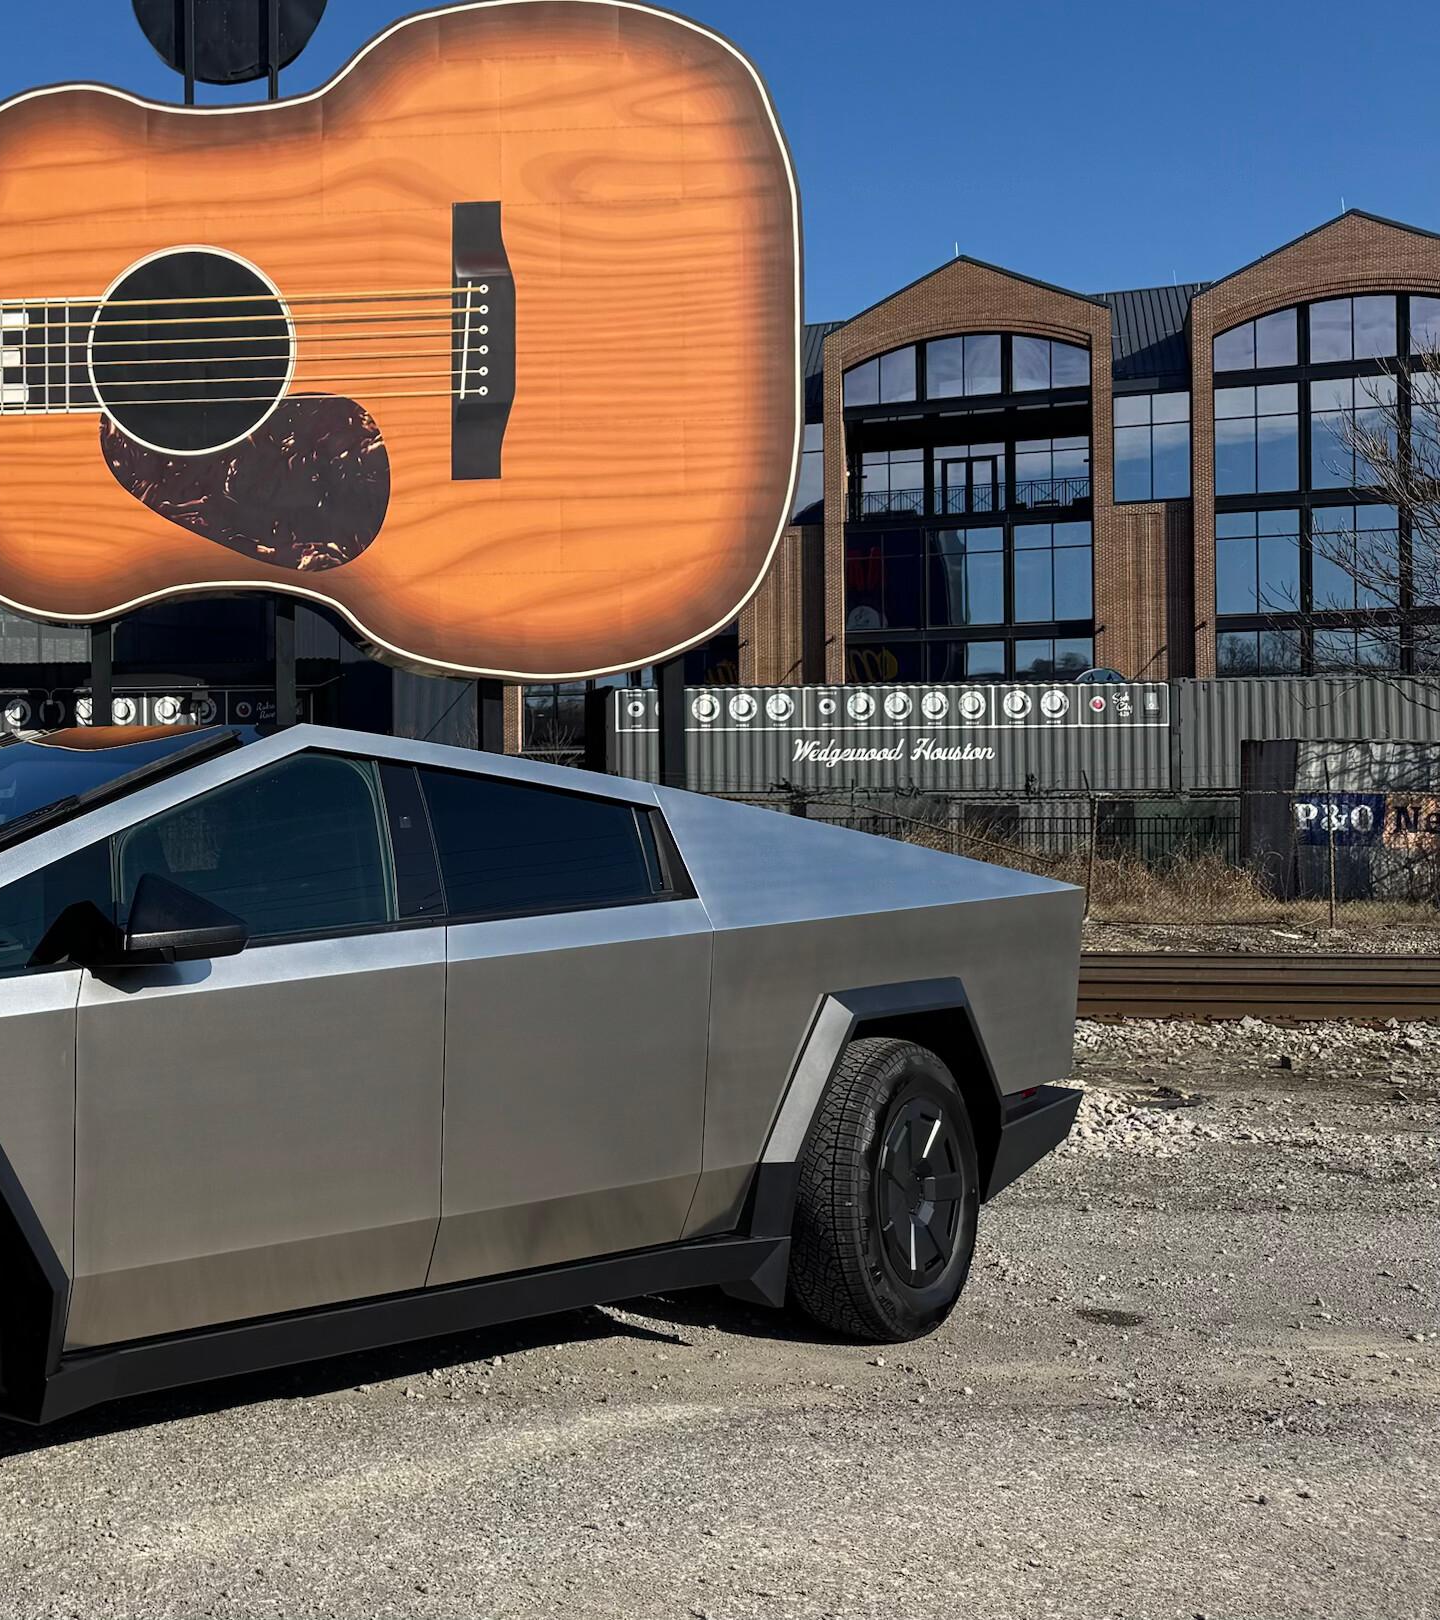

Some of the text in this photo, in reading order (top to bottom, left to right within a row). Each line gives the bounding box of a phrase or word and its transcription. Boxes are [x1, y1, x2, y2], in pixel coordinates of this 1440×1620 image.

[791, 738, 995, 767] Wedgewood Houston
[1294, 803, 1374, 831] P&O
